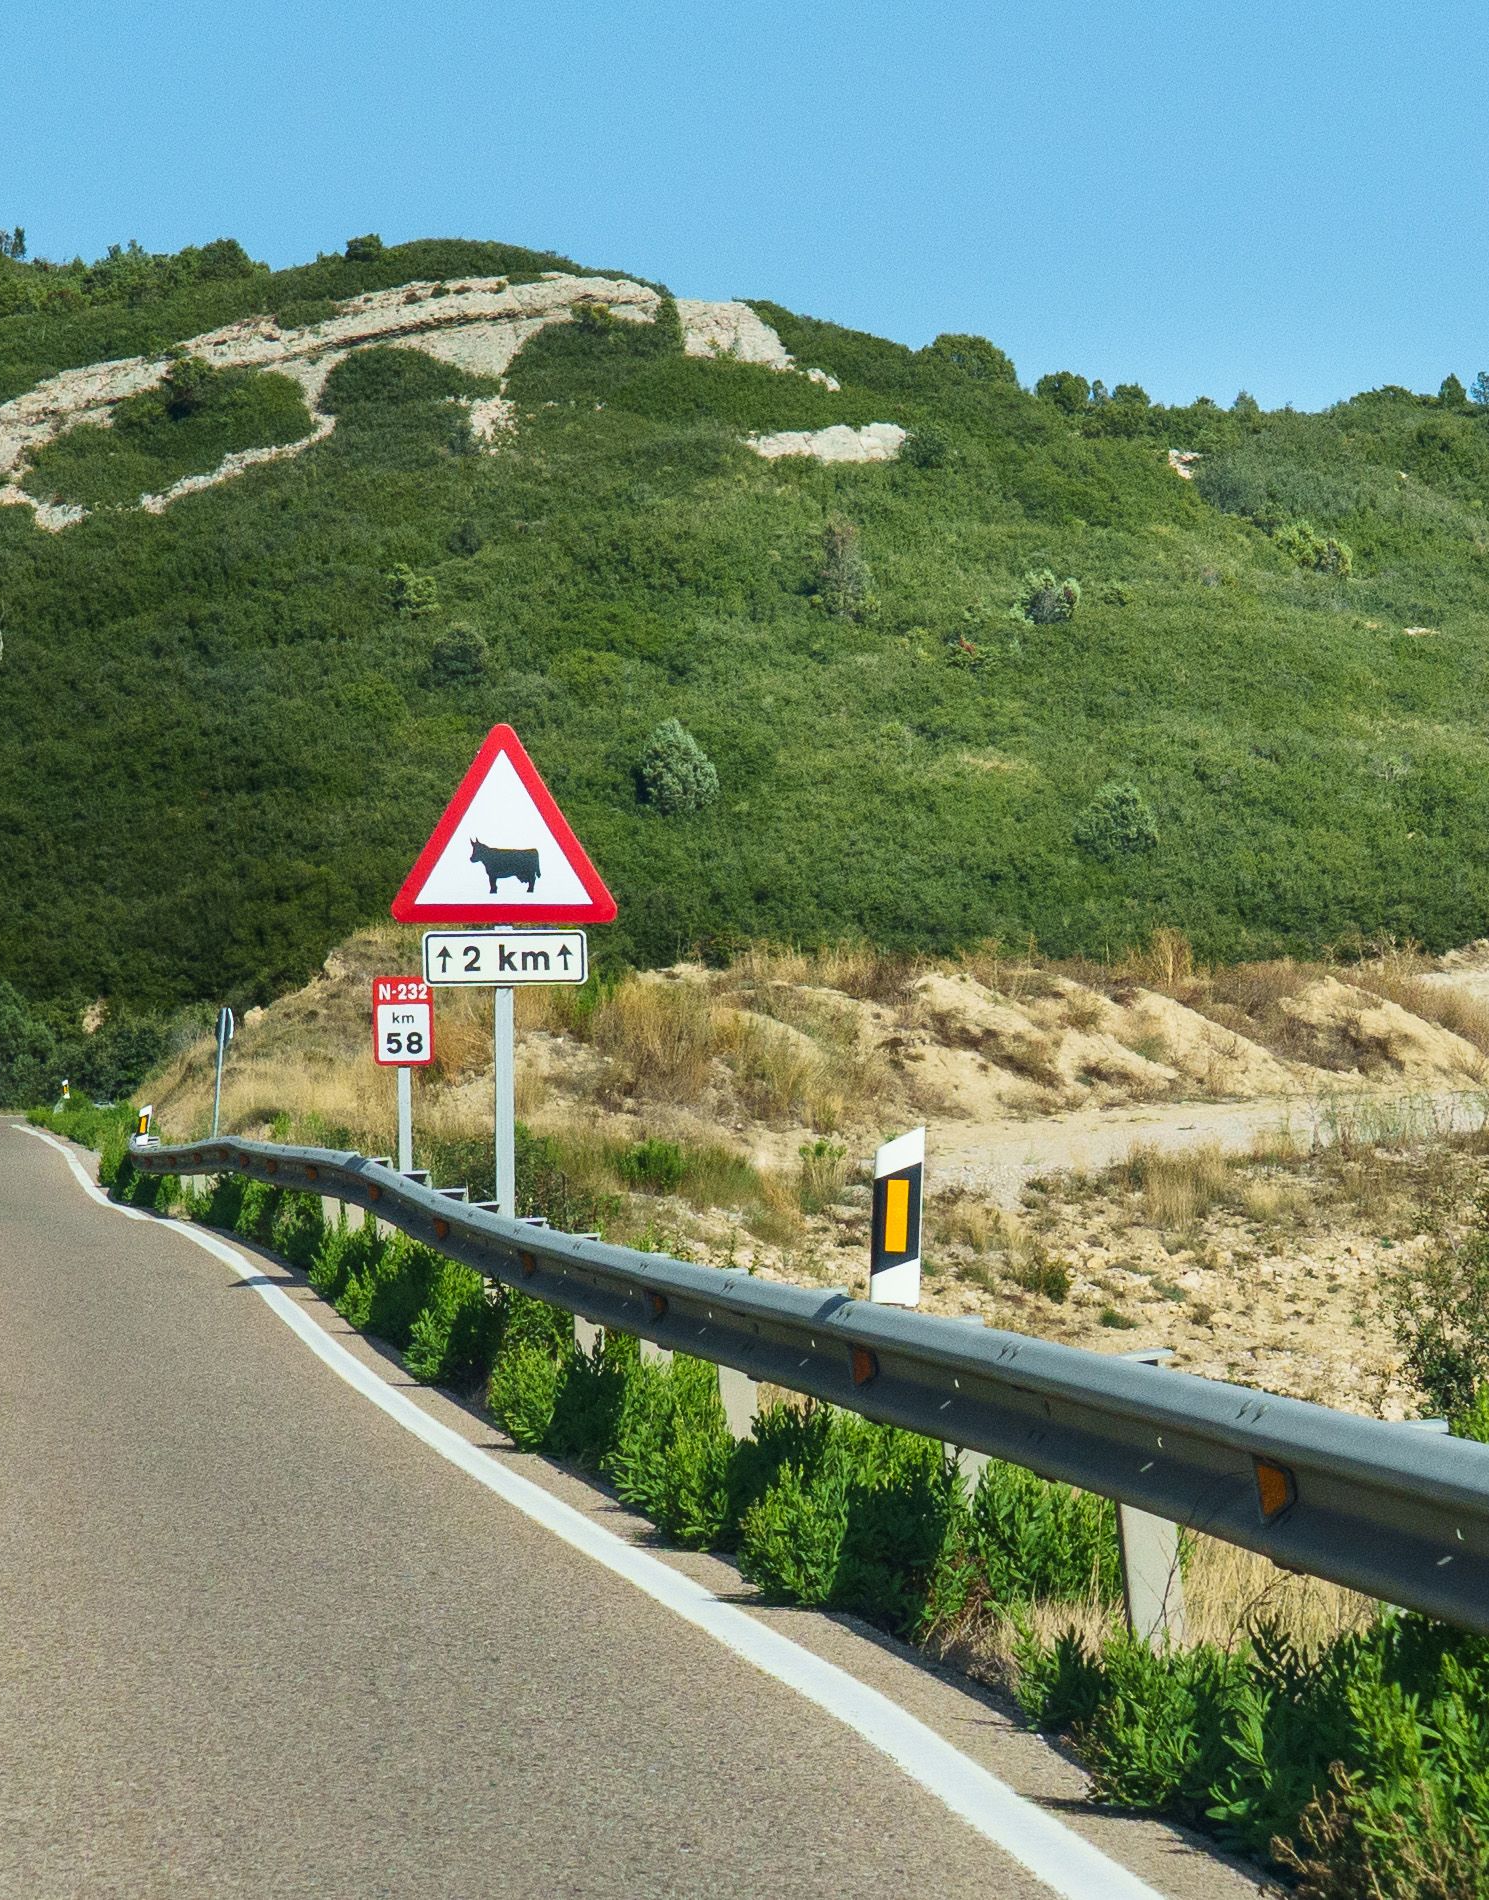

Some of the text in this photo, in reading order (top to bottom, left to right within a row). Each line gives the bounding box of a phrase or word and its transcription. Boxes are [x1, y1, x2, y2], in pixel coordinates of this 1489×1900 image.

[462, 944, 550, 972] 2 km
[378, 983, 428, 1000] N-232
[392, 1012, 415, 1024] km
[386, 1032, 423, 1054] 58
